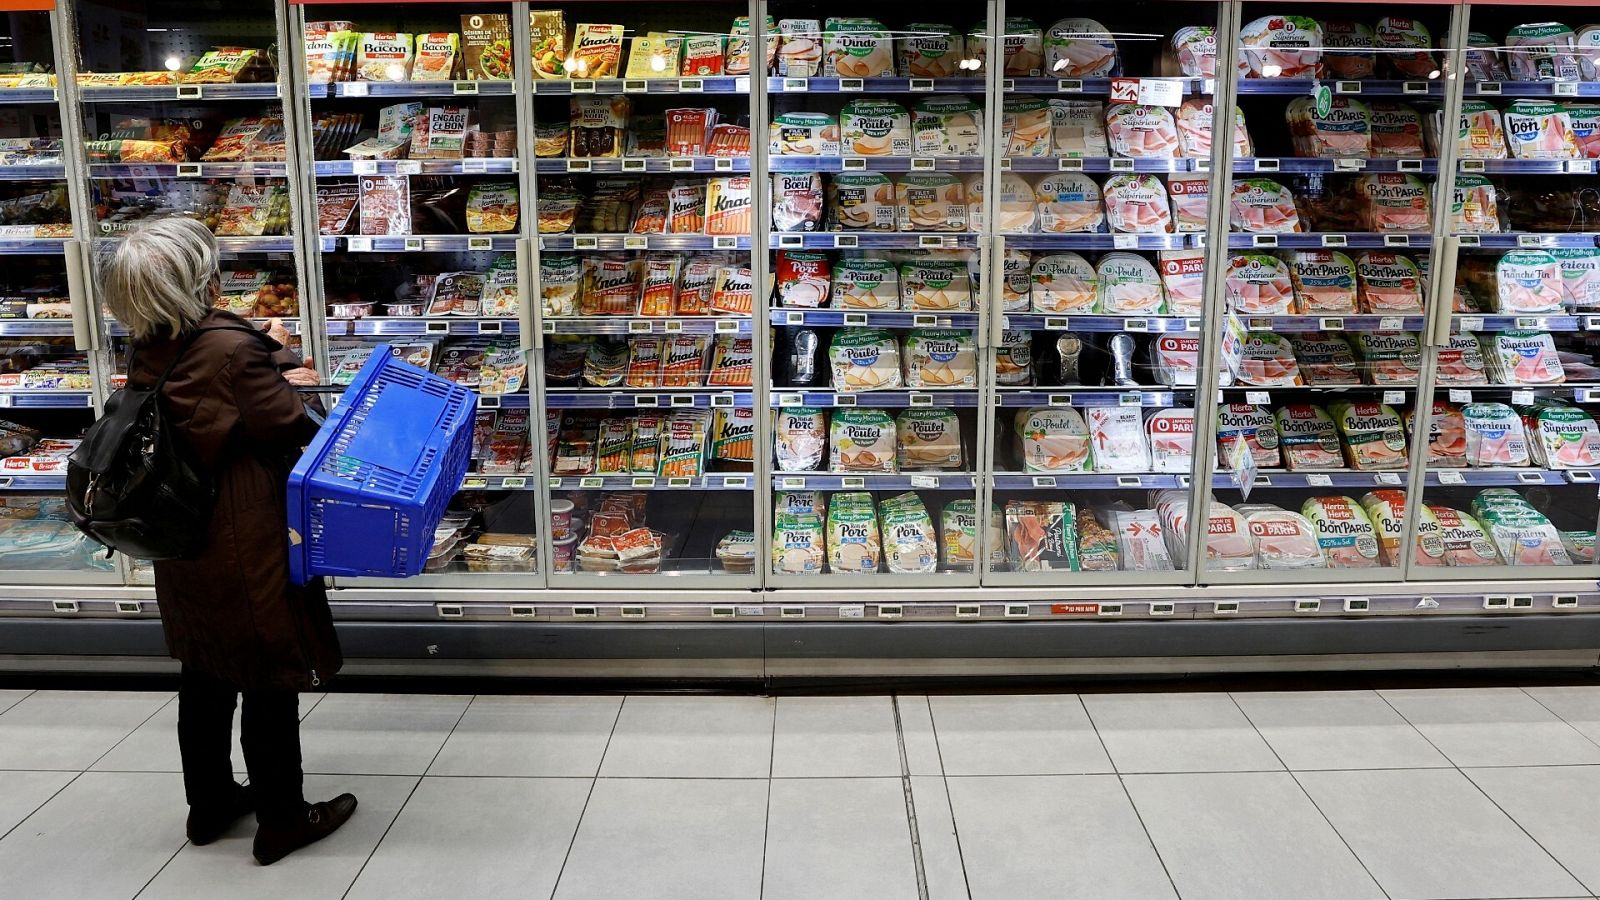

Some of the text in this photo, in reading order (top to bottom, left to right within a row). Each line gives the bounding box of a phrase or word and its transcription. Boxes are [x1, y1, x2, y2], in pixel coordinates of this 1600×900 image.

[1390, 19, 1411, 29] Herta
[579, 36, 619, 48] Knacki
[842, 36, 876, 47] Dinde
[915, 38, 948, 50] Poulet
[1004, 37, 1026, 45] nde
[1340, 37, 1372, 46] PARIS
[364, 43, 407, 53] Bacon
[422, 43, 452, 51] Bacon
[1336, 112, 1366, 120] PARIS
[1386, 115, 1416, 123] PARIS
[859, 118, 894, 129] Poulet
[1509, 116, 1540, 134] bon
[1572, 120, 1598, 129] chon
[1054, 183, 1084, 193] Poulet
[1393, 187, 1424, 197] PARIS
[1116, 192, 1153, 200] Supérieur
[1241, 196, 1279, 204] Supérieur
[791, 262, 819, 273] Porc
[1003, 260, 1019, 269] let
[1050, 264, 1077, 275] Poulet
[1561, 260, 1596, 270] érieur
[920, 270, 953, 281] Poulet
[1116, 267, 1142, 277] Poulet
[1238, 271, 1276, 279] Supérieur
[1321, 266, 1349, 275] PARIS
[1383, 268, 1414, 277] PARIS
[593, 272, 637, 290] Knacki
[646, 276, 672, 285] Knacki
[850, 272, 884, 282] Poulet
[835, 288, 841, 296] 4
[840, 335, 879, 345] Fleury Michon
[1386, 338, 1417, 348] PARIS
[1451, 339, 1477, 347] PARIS
[1500, 339, 1545, 350] Supérieur
[926, 341, 959, 353] Poulet
[1315, 342, 1347, 351] PARIS
[668, 350, 701, 362] Knacki
[848, 347, 880, 359] Poulet
[1243, 348, 1278, 356] Supérieur
[912, 362, 917, 370] 4
[1231, 404, 1252, 412] Herta
[1357, 407, 1377, 415] Herta
[789, 417, 813, 429] Porc
[845, 415, 861, 423] Fleury
[1243, 415, 1273, 425] PARIS
[1369, 417, 1399, 427] PARIS
[913, 422, 945, 432] Poulet
[1043, 419, 1070, 430] Poulet
[1303, 421, 1334, 431] PARIS
[1543, 422, 1588, 433] Supérieur
[848, 426, 881, 438] Poulet
[602, 434, 632, 447] Knacki
[634, 434, 659, 444] Knacki
[664, 443, 701, 457] Knacki
[6, 460, 25, 469] Herta
[786, 494, 813, 507] Porc
[1328, 510, 1350, 518] Herta
[839, 524, 868, 537] Porc
[1267, 526, 1297, 535] PARIS
[1342, 523, 1372, 532] PARIS
[784, 531, 812, 544] Porc
[1457, 530, 1483, 538] PARIS
[779, 555, 784, 563] 2
[835, 552, 841, 560] 4
[893, 552, 898, 560] 6
